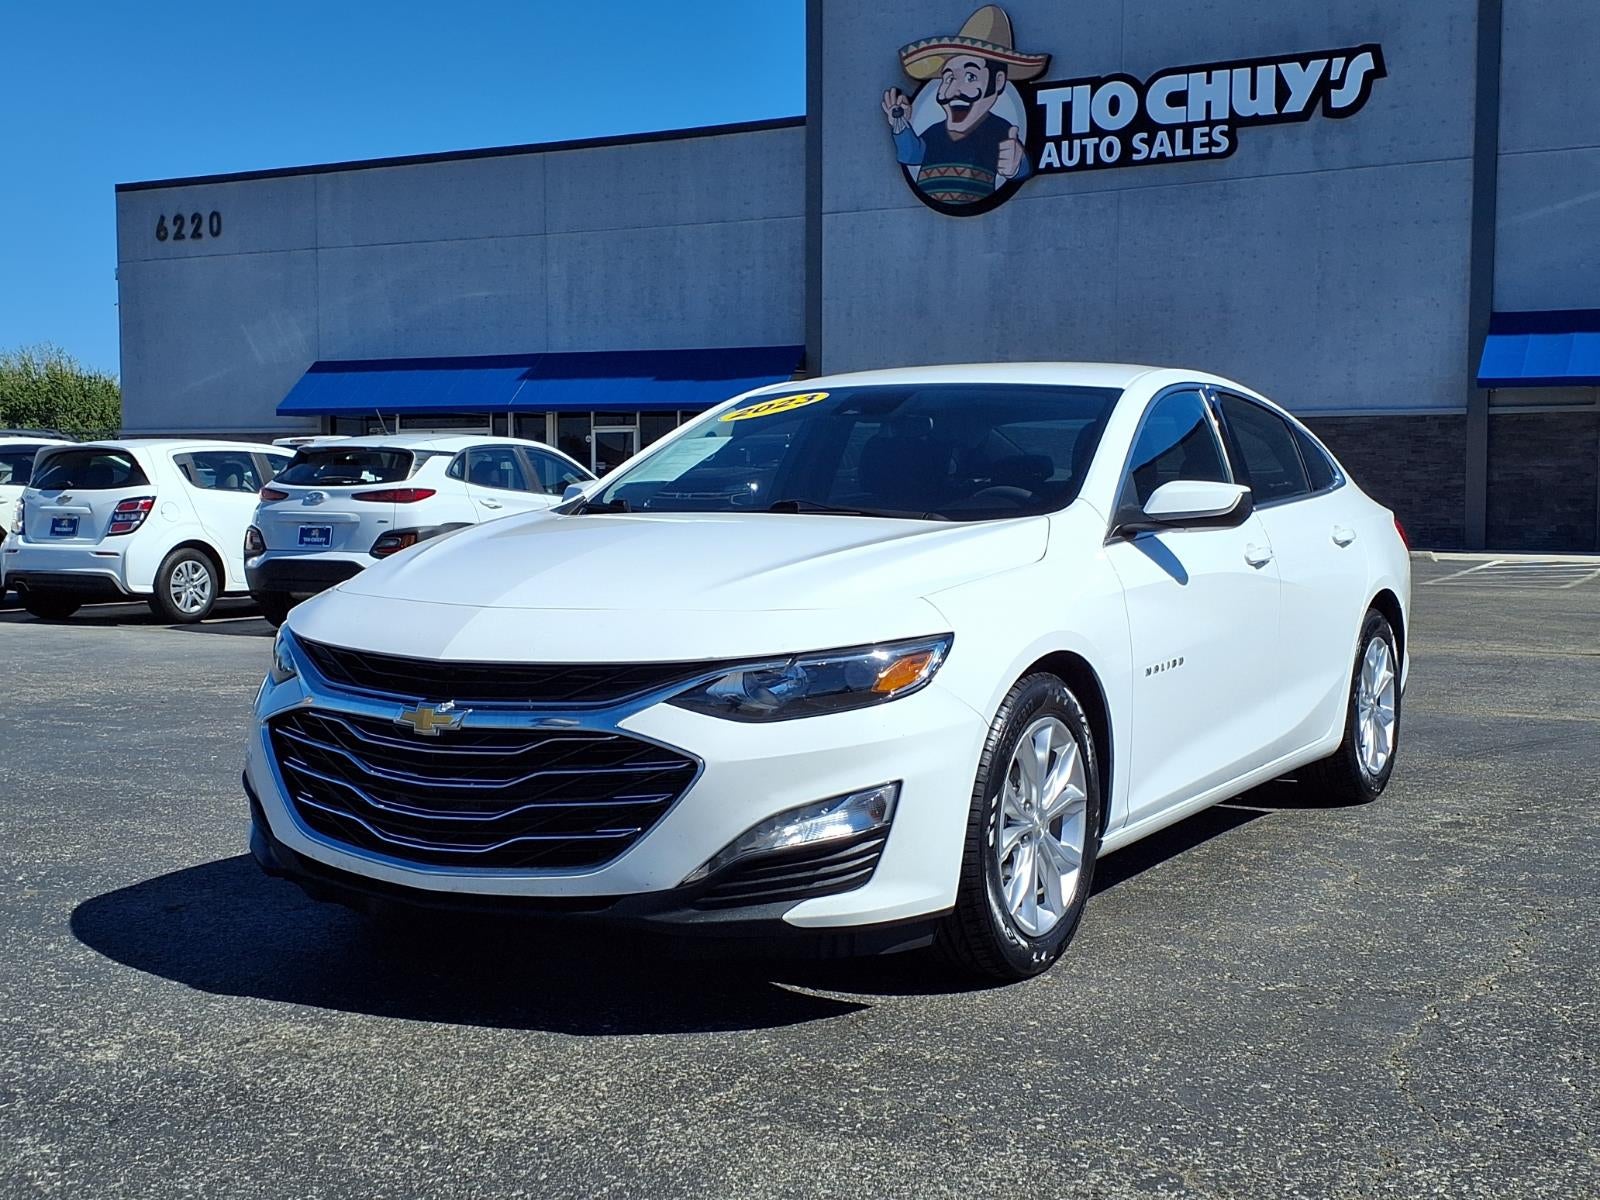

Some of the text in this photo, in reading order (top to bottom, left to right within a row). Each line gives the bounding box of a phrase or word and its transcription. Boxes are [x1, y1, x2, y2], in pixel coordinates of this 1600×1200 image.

[1036, 51, 1375, 137] TIO CHUY'S
[1038, 124, 1230, 169] AUTO SALES
[155, 210, 222, 242] 6220
